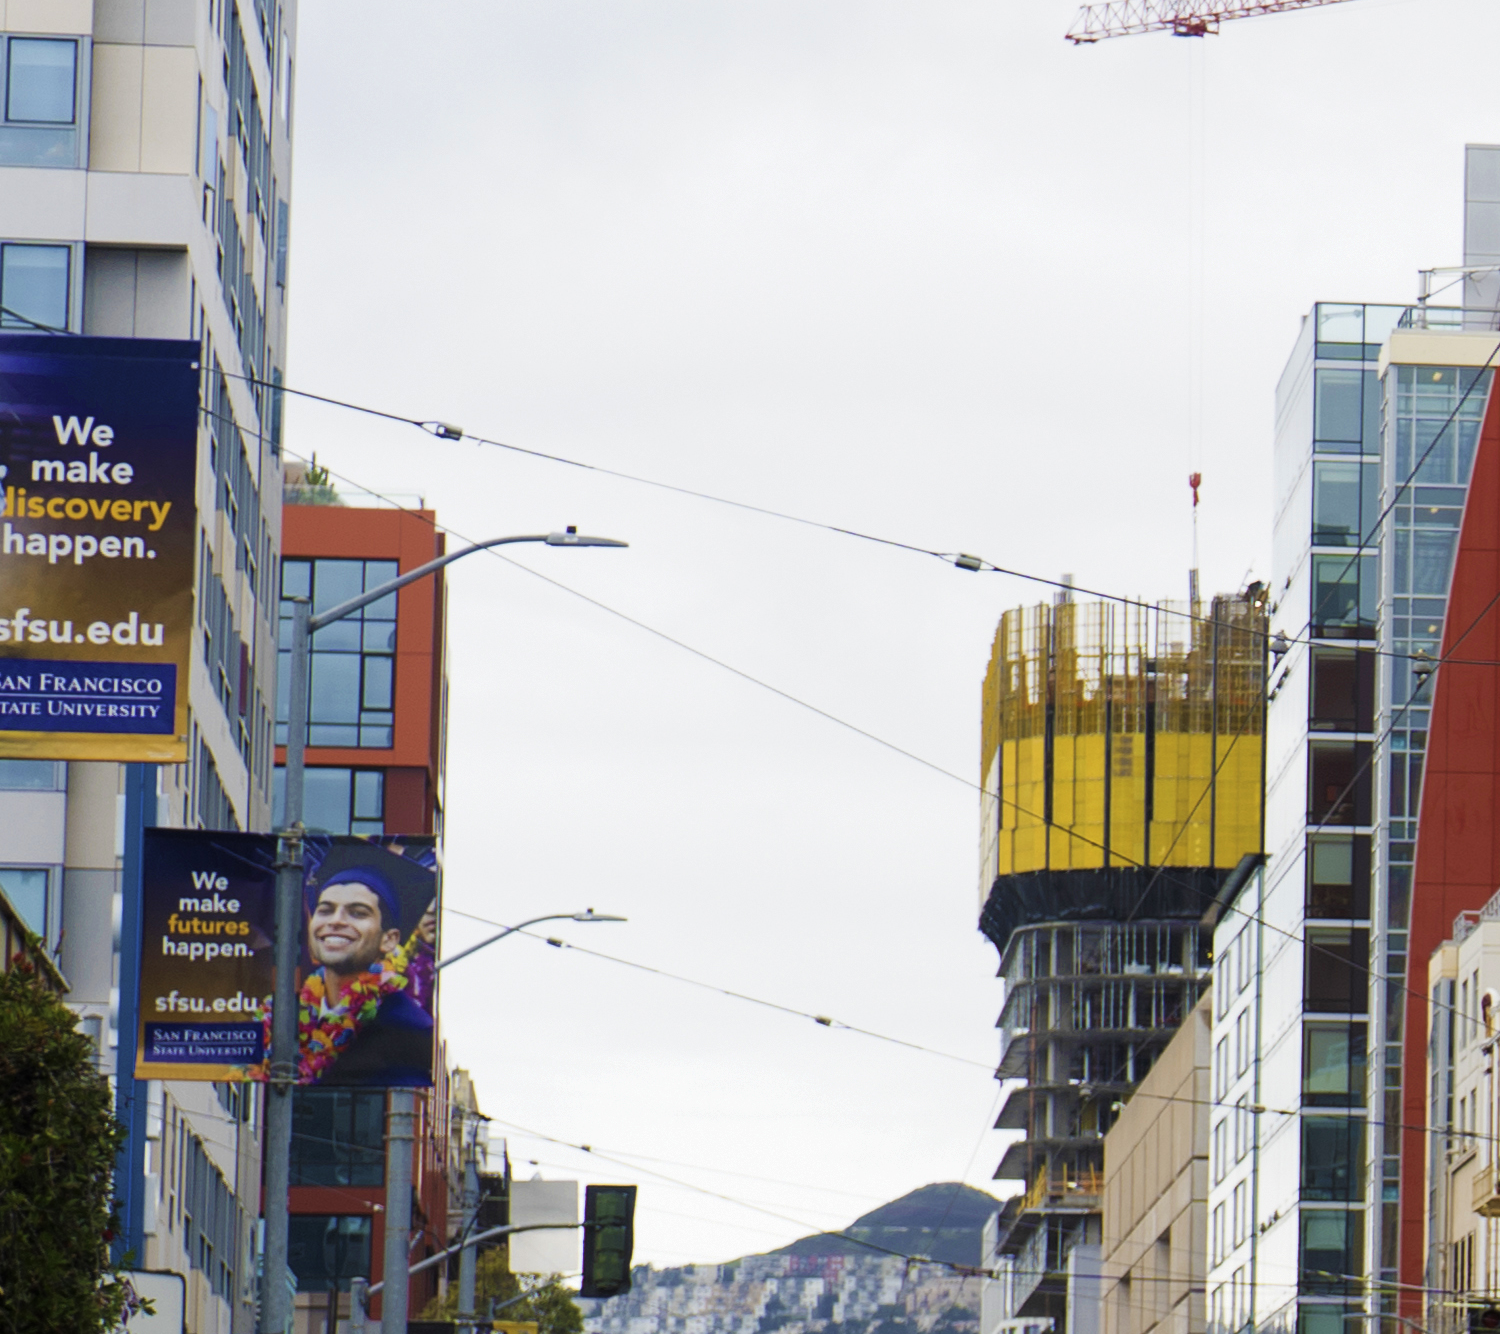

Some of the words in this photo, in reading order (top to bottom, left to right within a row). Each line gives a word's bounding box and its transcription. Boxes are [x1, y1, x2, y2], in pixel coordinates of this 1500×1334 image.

[52, 414, 115, 447] We
[31, 452, 134, 486] make
[2, 522, 157, 564] happen.
[39, 673, 163, 695] FRANCISCO
[47, 700, 161, 719] UNIVERSITY
[191, 871, 229, 891] We
[179, 893, 241, 913] make
[168, 913, 249, 935] futures
[162, 935, 254, 961] happen.
[155, 990, 258, 1013] sfsu.edu
[183, 1029, 257, 1042] FRANCISCO
[188, 1045, 256, 1056] UNIVERSITY
